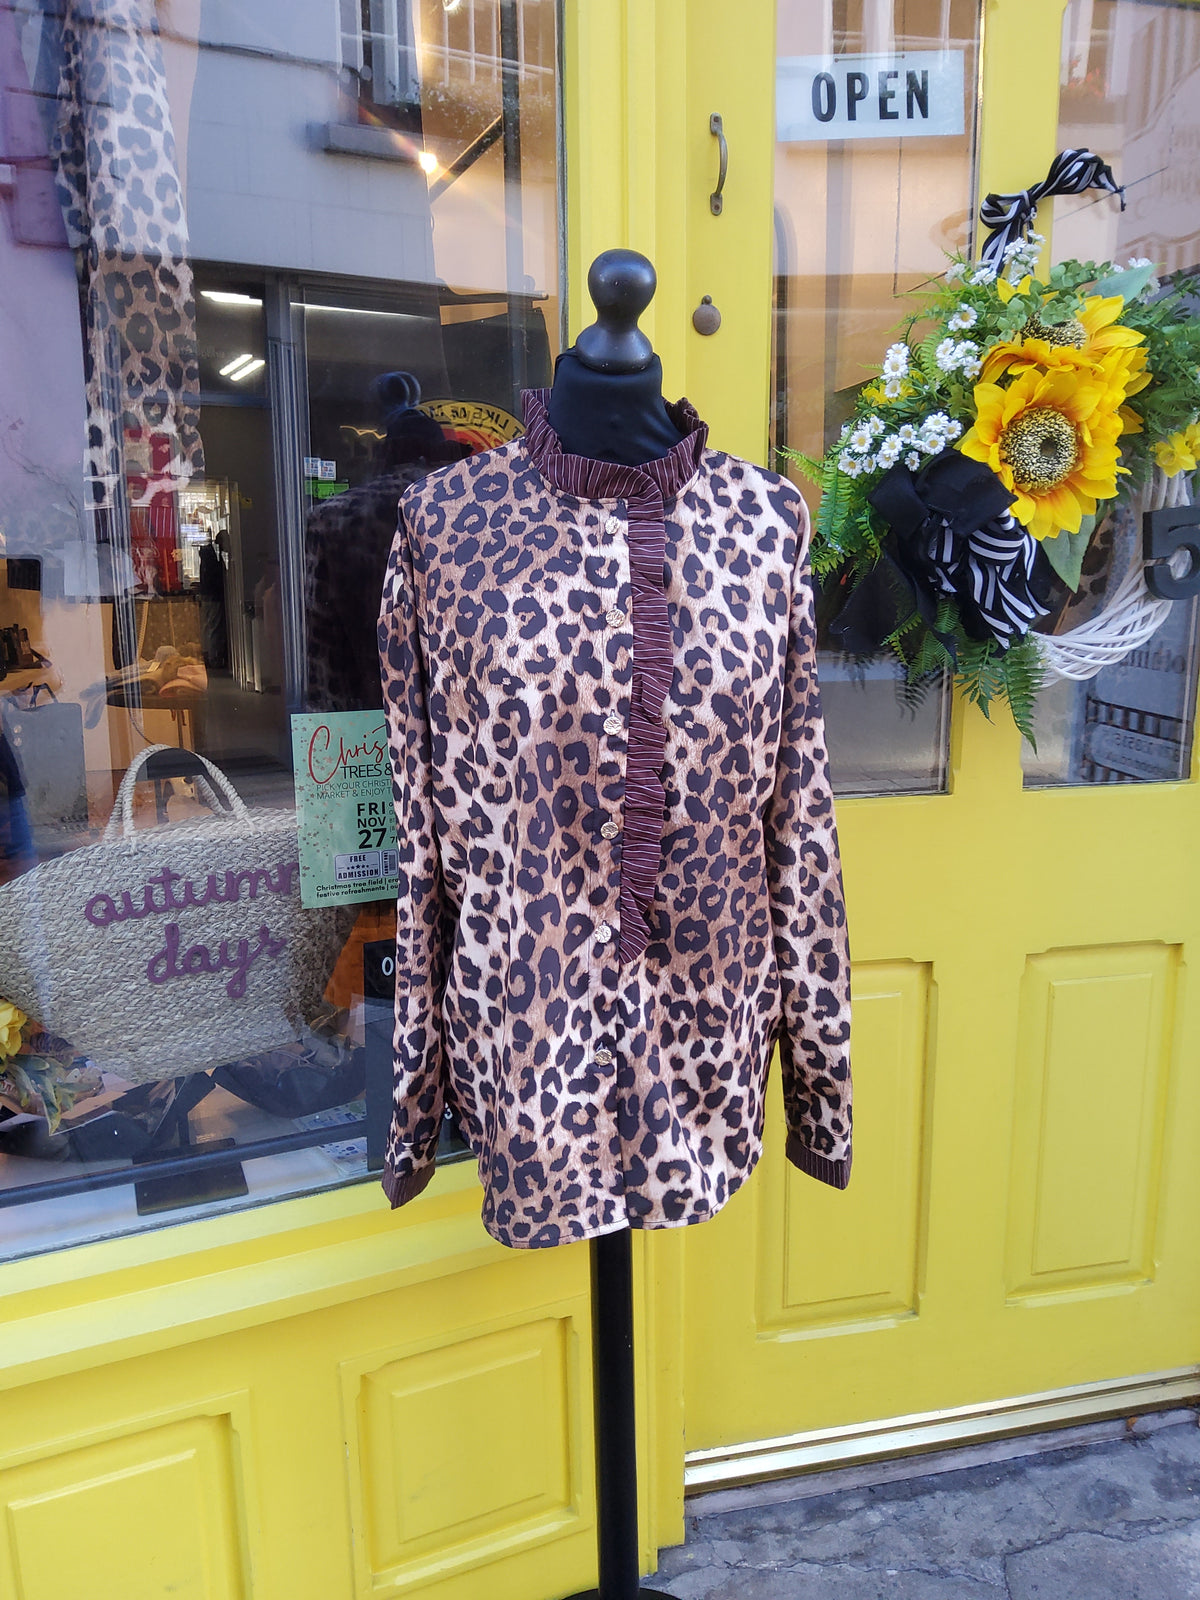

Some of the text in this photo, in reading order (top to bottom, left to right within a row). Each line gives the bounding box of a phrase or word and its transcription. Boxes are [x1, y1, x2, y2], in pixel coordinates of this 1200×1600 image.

[811, 70, 929, 122] OPEN
[308, 725, 388, 784] Chris
[340, 764, 382, 779] TREES
[316, 779, 392, 792] PICK YOUR CHRIST
[316, 791, 350, 800] MARKET
[361, 787, 385, 797] ENJOY
[357, 801, 386, 816] FRI
[357, 816, 386, 828] NOV
[358, 828, 387, 849] 27
[349, 854, 366, 862] FREE
[338, 869, 379, 879] ADMISSION
[316, 883, 351, 892] Christmas
[368, 878, 383, 886] field
[316, 890, 340, 898] festive
[341, 885, 385, 895] refreshments
[147, 922, 287, 998] days
